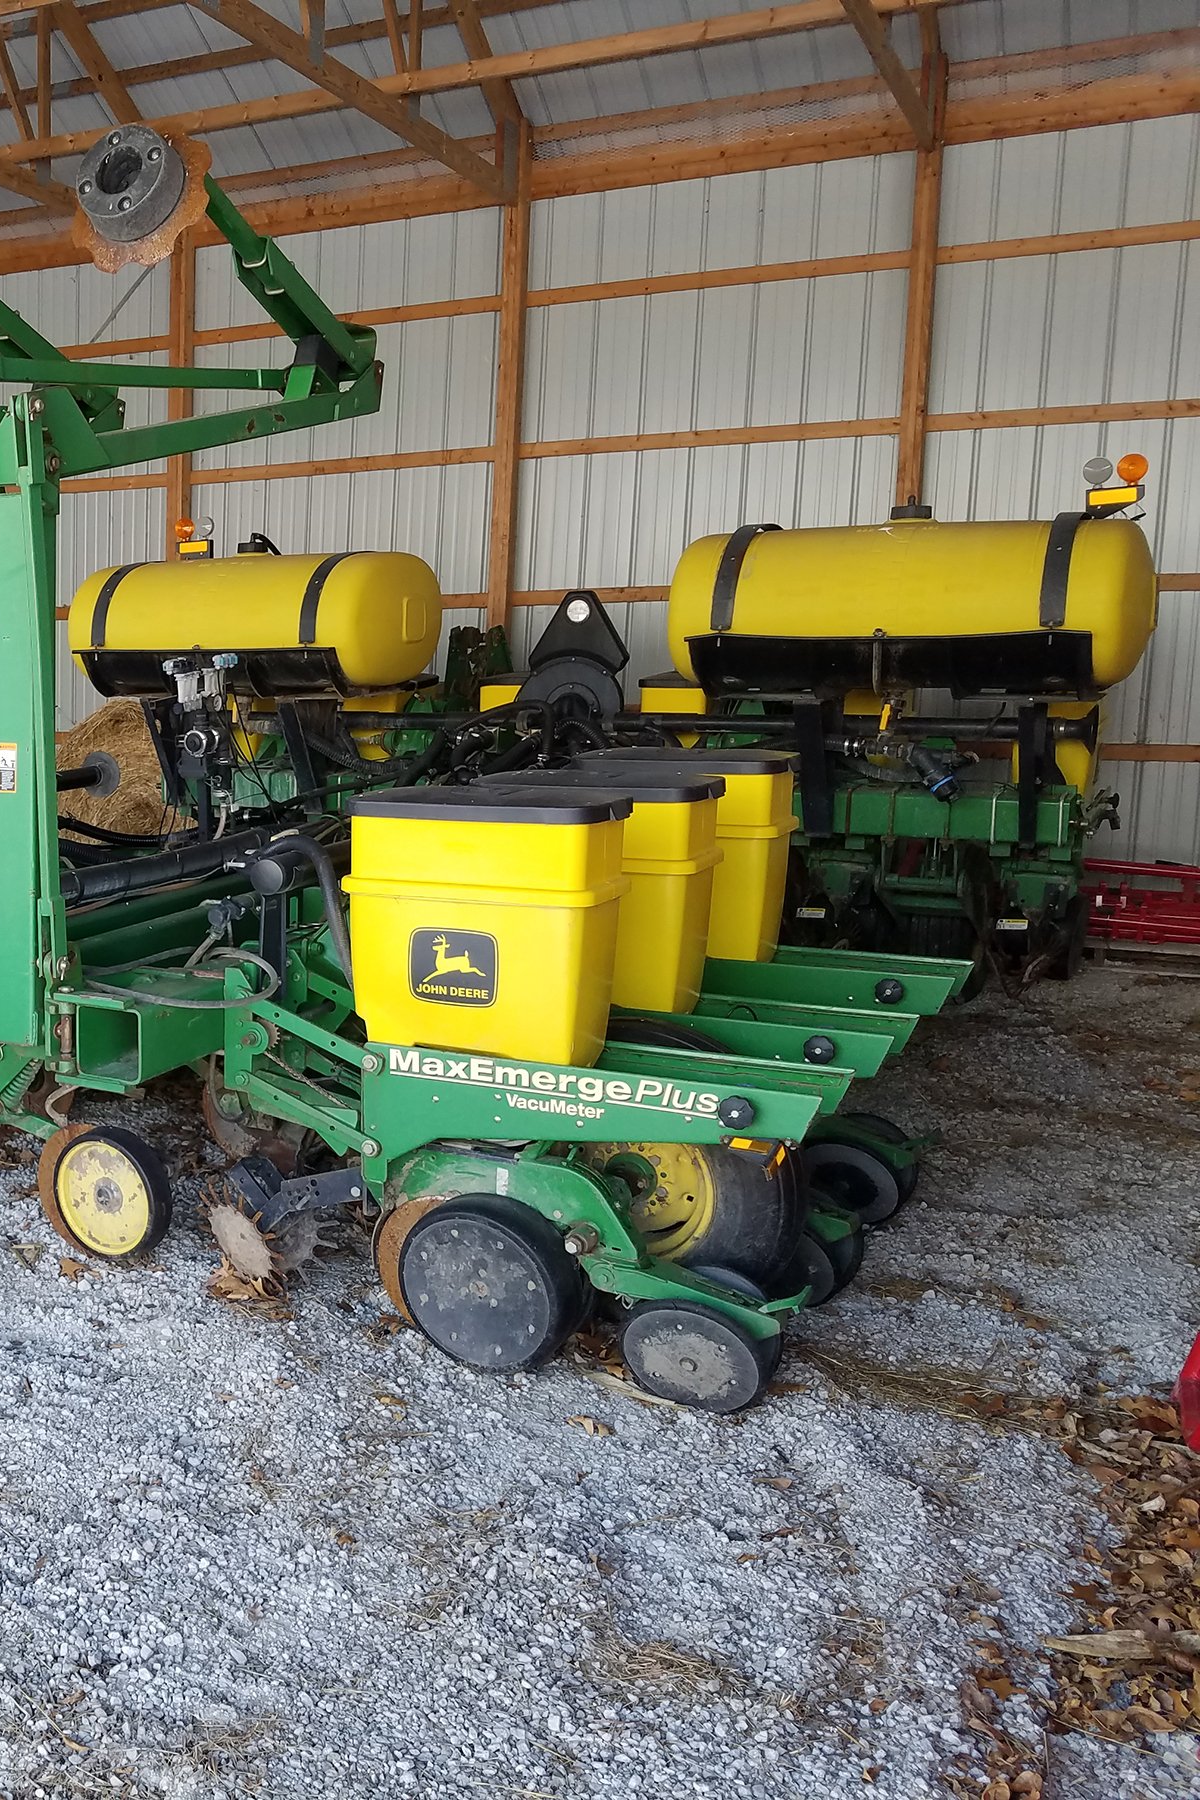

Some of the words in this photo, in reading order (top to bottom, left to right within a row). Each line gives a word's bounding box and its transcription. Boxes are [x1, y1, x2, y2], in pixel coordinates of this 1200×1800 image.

[416, 983, 448, 995] JOHN
[449, 986, 489, 999] DEERE
[506, 1092, 605, 1119] VacuMeter
